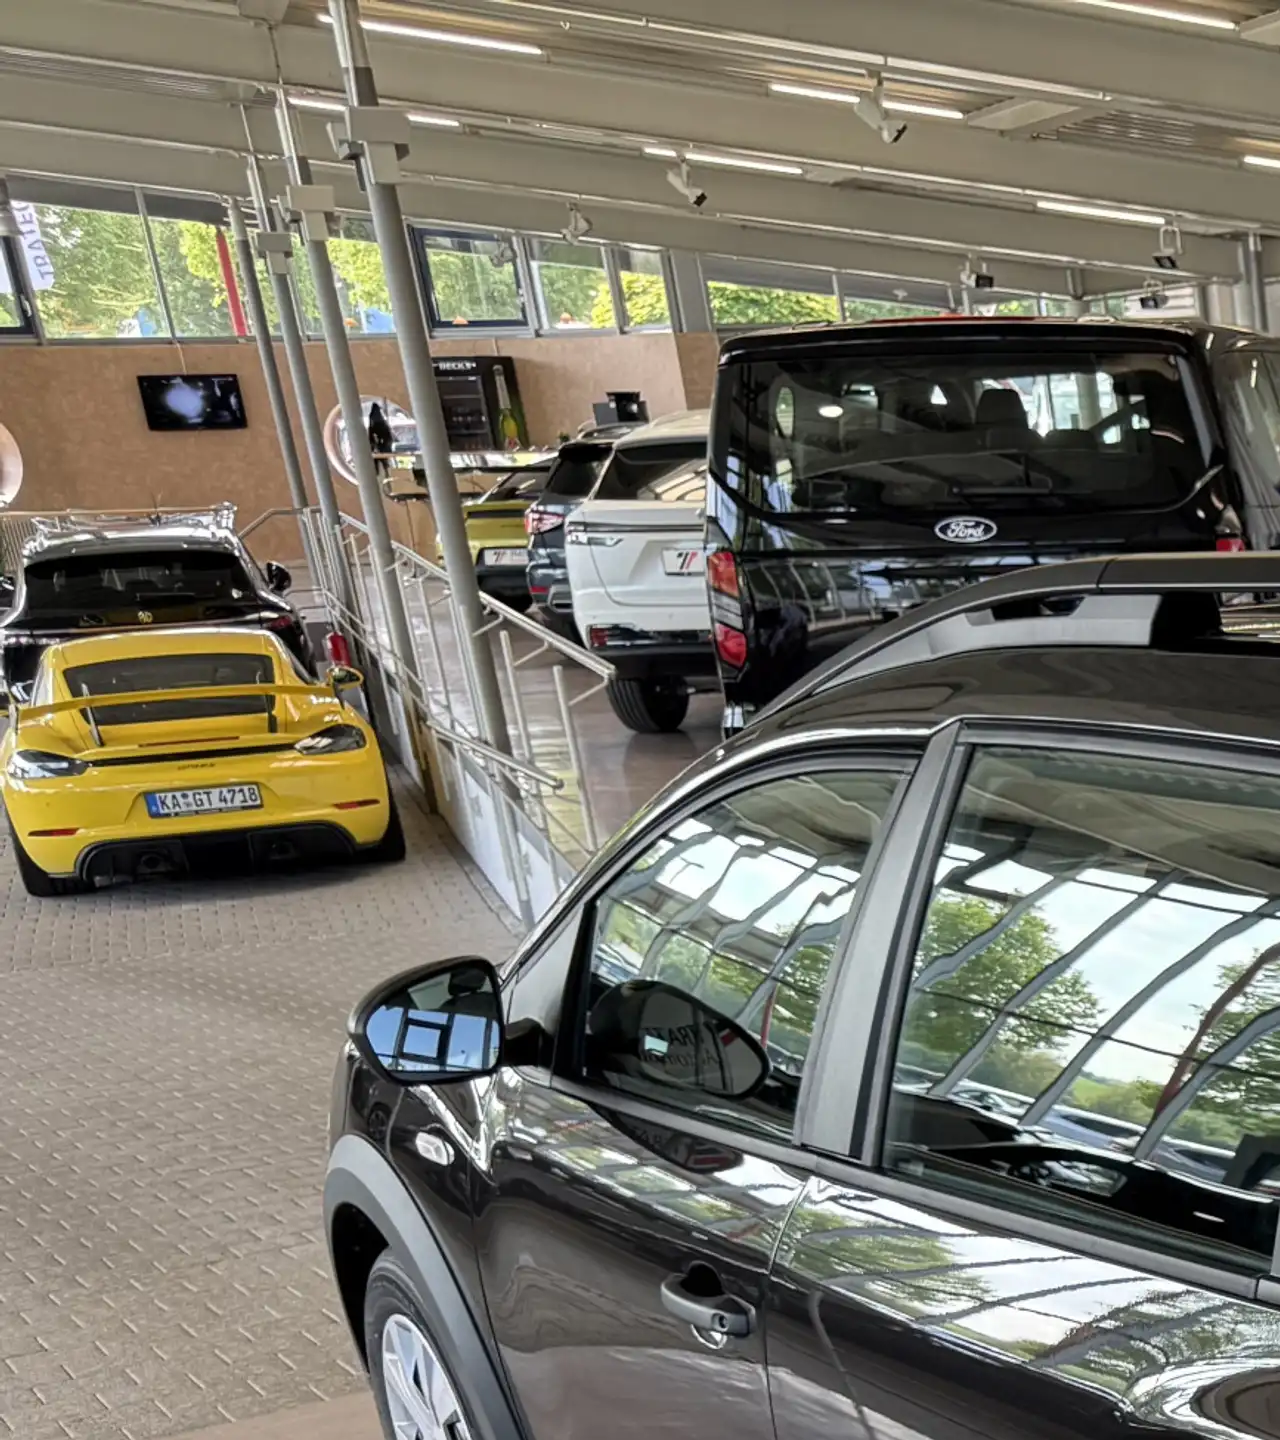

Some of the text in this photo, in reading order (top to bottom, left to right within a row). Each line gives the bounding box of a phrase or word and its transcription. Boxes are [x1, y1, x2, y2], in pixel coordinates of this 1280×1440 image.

[946, 521, 985, 538] Ford
[158, 794, 182, 811] KA
[192, 790, 213, 808] GT
[218, 787, 258, 805] 4718
